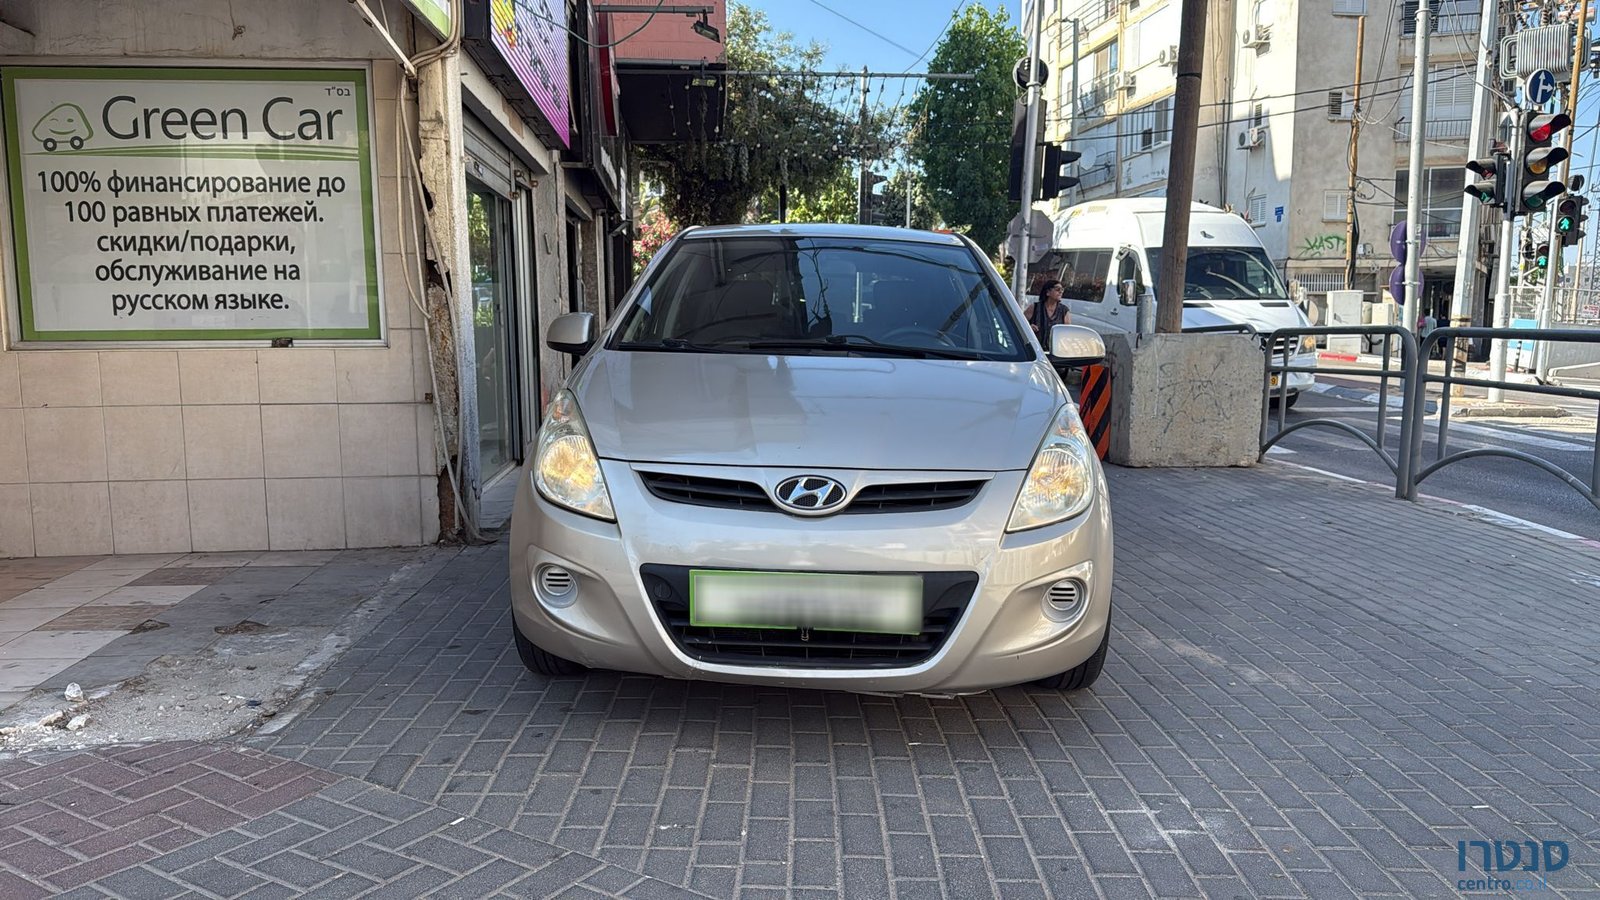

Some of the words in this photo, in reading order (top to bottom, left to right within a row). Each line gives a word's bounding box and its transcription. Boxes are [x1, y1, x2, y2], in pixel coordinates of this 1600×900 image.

[101, 95, 248, 140] Green
[261, 96, 343, 141] Car
[37, 171, 101, 193] 100%
[107, 169, 311, 197] финансирование
[316, 175, 346, 196] до
[64, 201, 106, 223] 100
[112, 204, 201, 228] равных
[207, 201, 324, 223] платежей.
[97, 230, 296, 256] скидки/подарки,
[95, 259, 268, 286] обслуживание
[274, 265, 301, 281] на
[112, 293, 209, 316] русском
[215, 293, 289, 310] языке.
